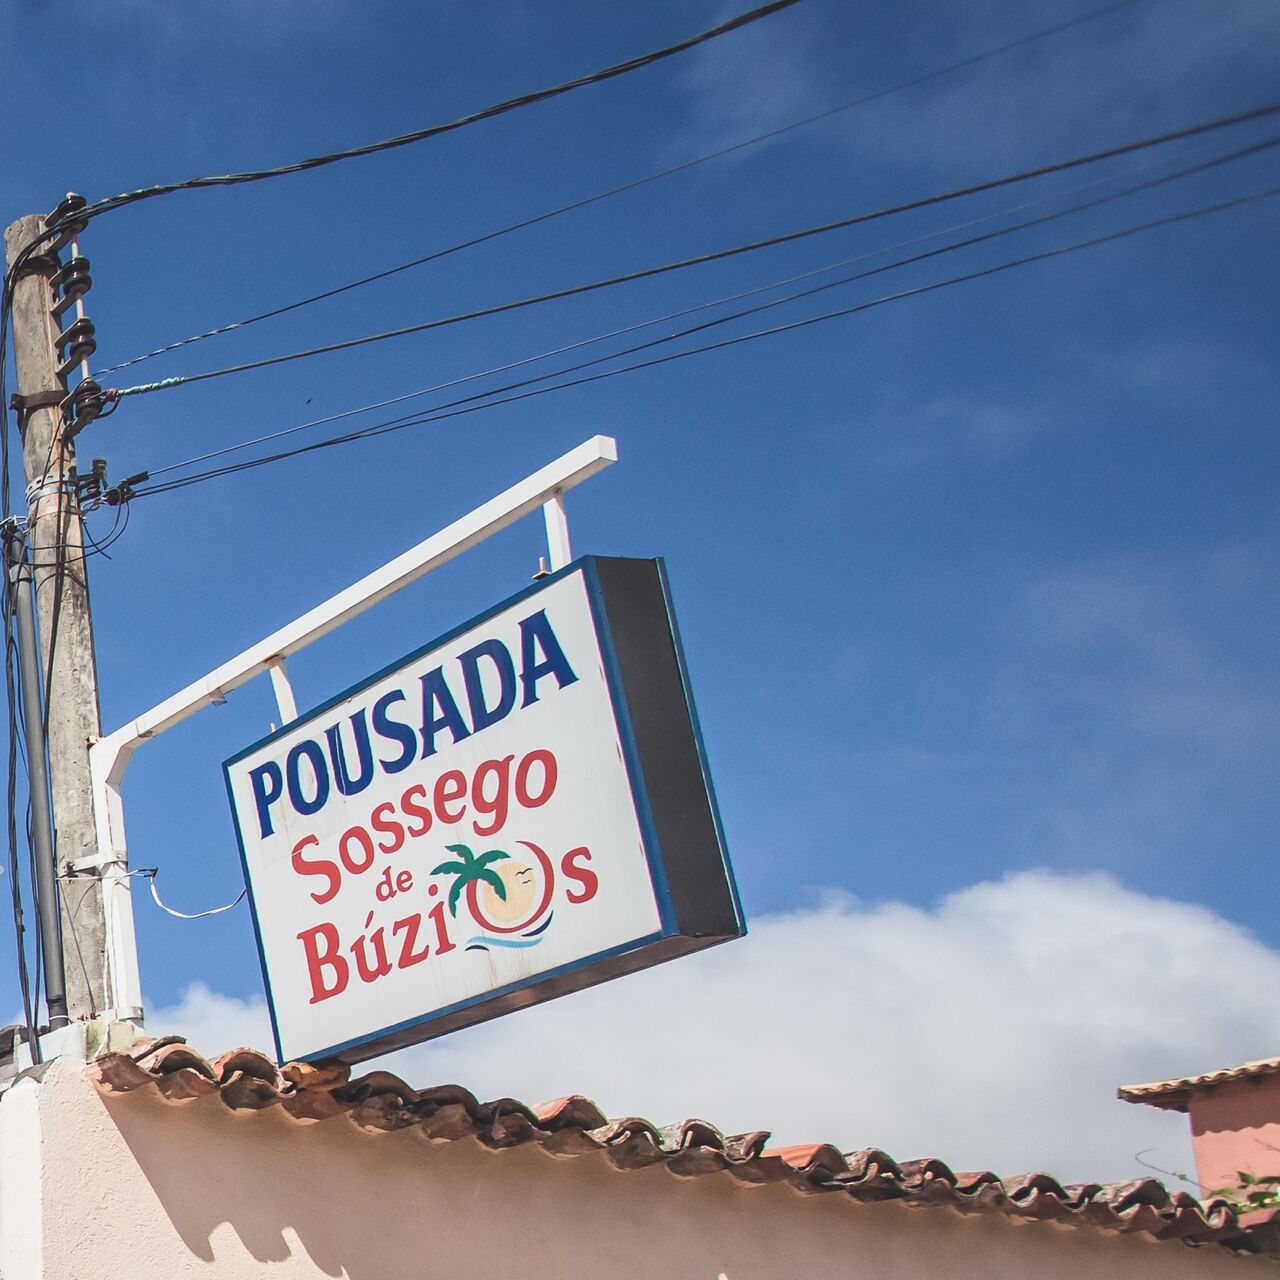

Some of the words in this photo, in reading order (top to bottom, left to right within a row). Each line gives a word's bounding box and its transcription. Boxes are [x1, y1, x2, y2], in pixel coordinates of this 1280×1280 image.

[248, 608, 579, 840] POUSADA
[291, 748, 558, 906] Sossego
[375, 866, 414, 902] de
